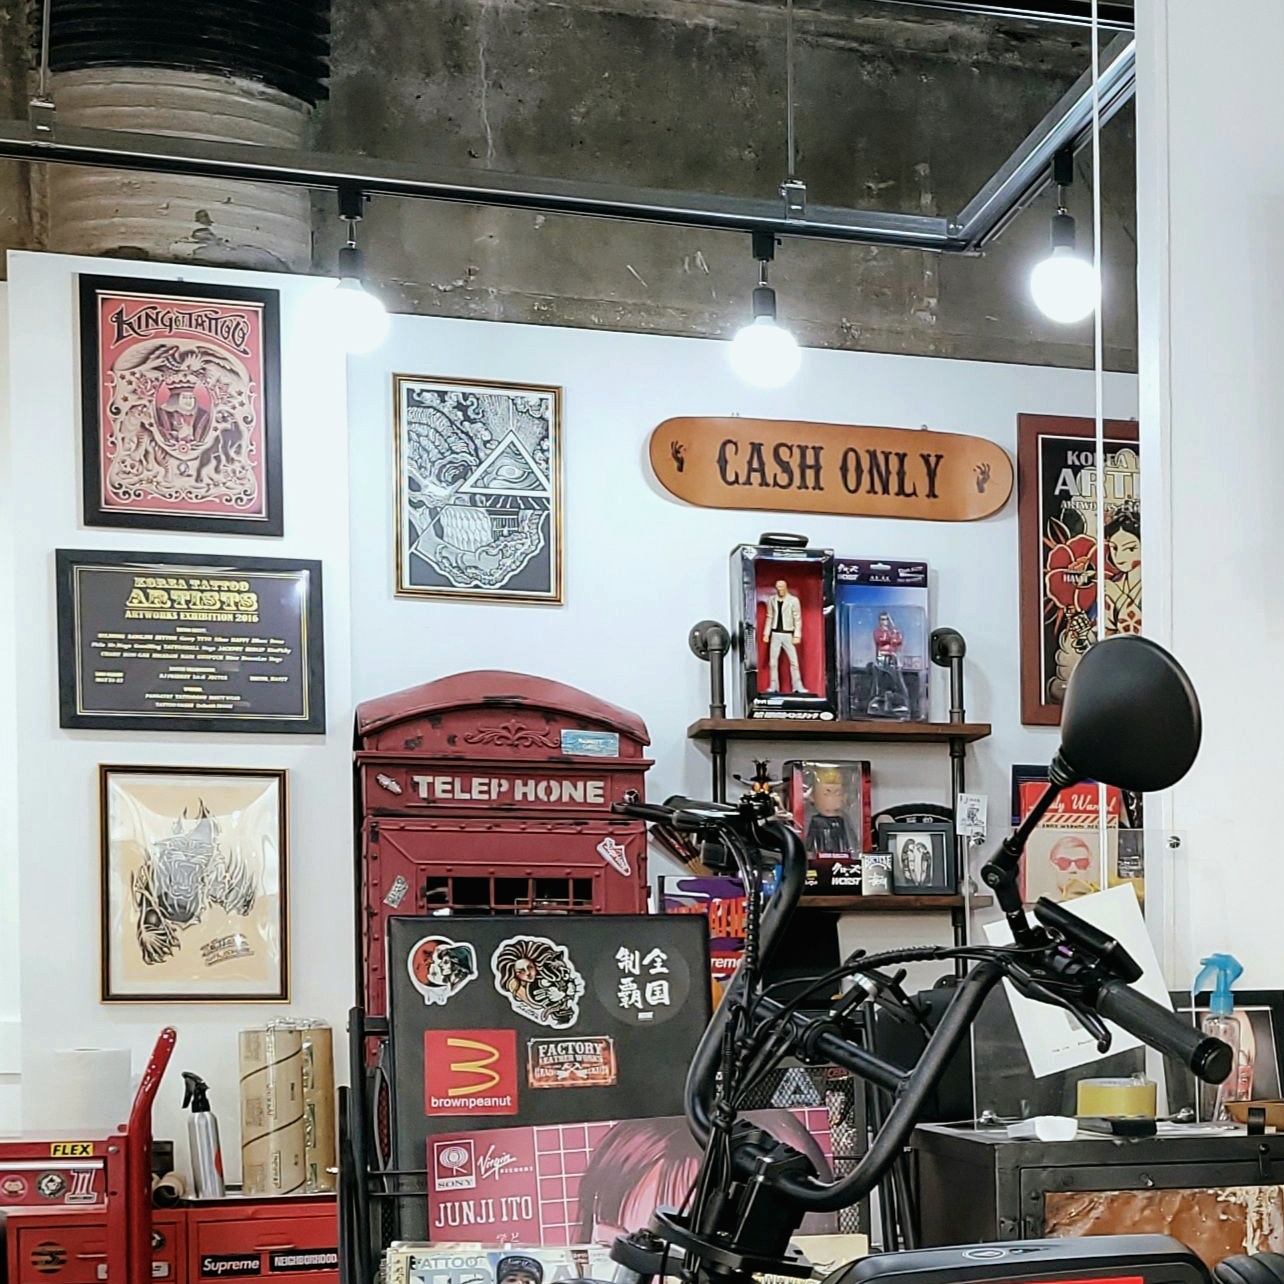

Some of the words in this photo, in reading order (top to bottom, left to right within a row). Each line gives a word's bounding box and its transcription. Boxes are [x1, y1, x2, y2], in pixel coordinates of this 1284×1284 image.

[716, 439, 824, 492] CASH
[839, 447, 945, 499] ONLY
[1054, 468, 1140, 500] ARTI
[134, 577, 187, 589] KOREA
[189, 579, 250, 592] TATTOO
[126, 588, 258, 612] ARTISTS
[412, 775, 605, 804] TELEPHONE
[538, 1041, 603, 1057] FACTORY
[431, 1096, 511, 1108] brownpeanut
[52, 1145, 91, 1156] FLEX
[477, 1144, 517, 1181] Virgin
[437, 1178, 473, 1188] SONY
[435, 1199, 495, 1228] JUNJI
[501, 1196, 533, 1222] ITO
[203, 1258, 260, 1274] Supreme
